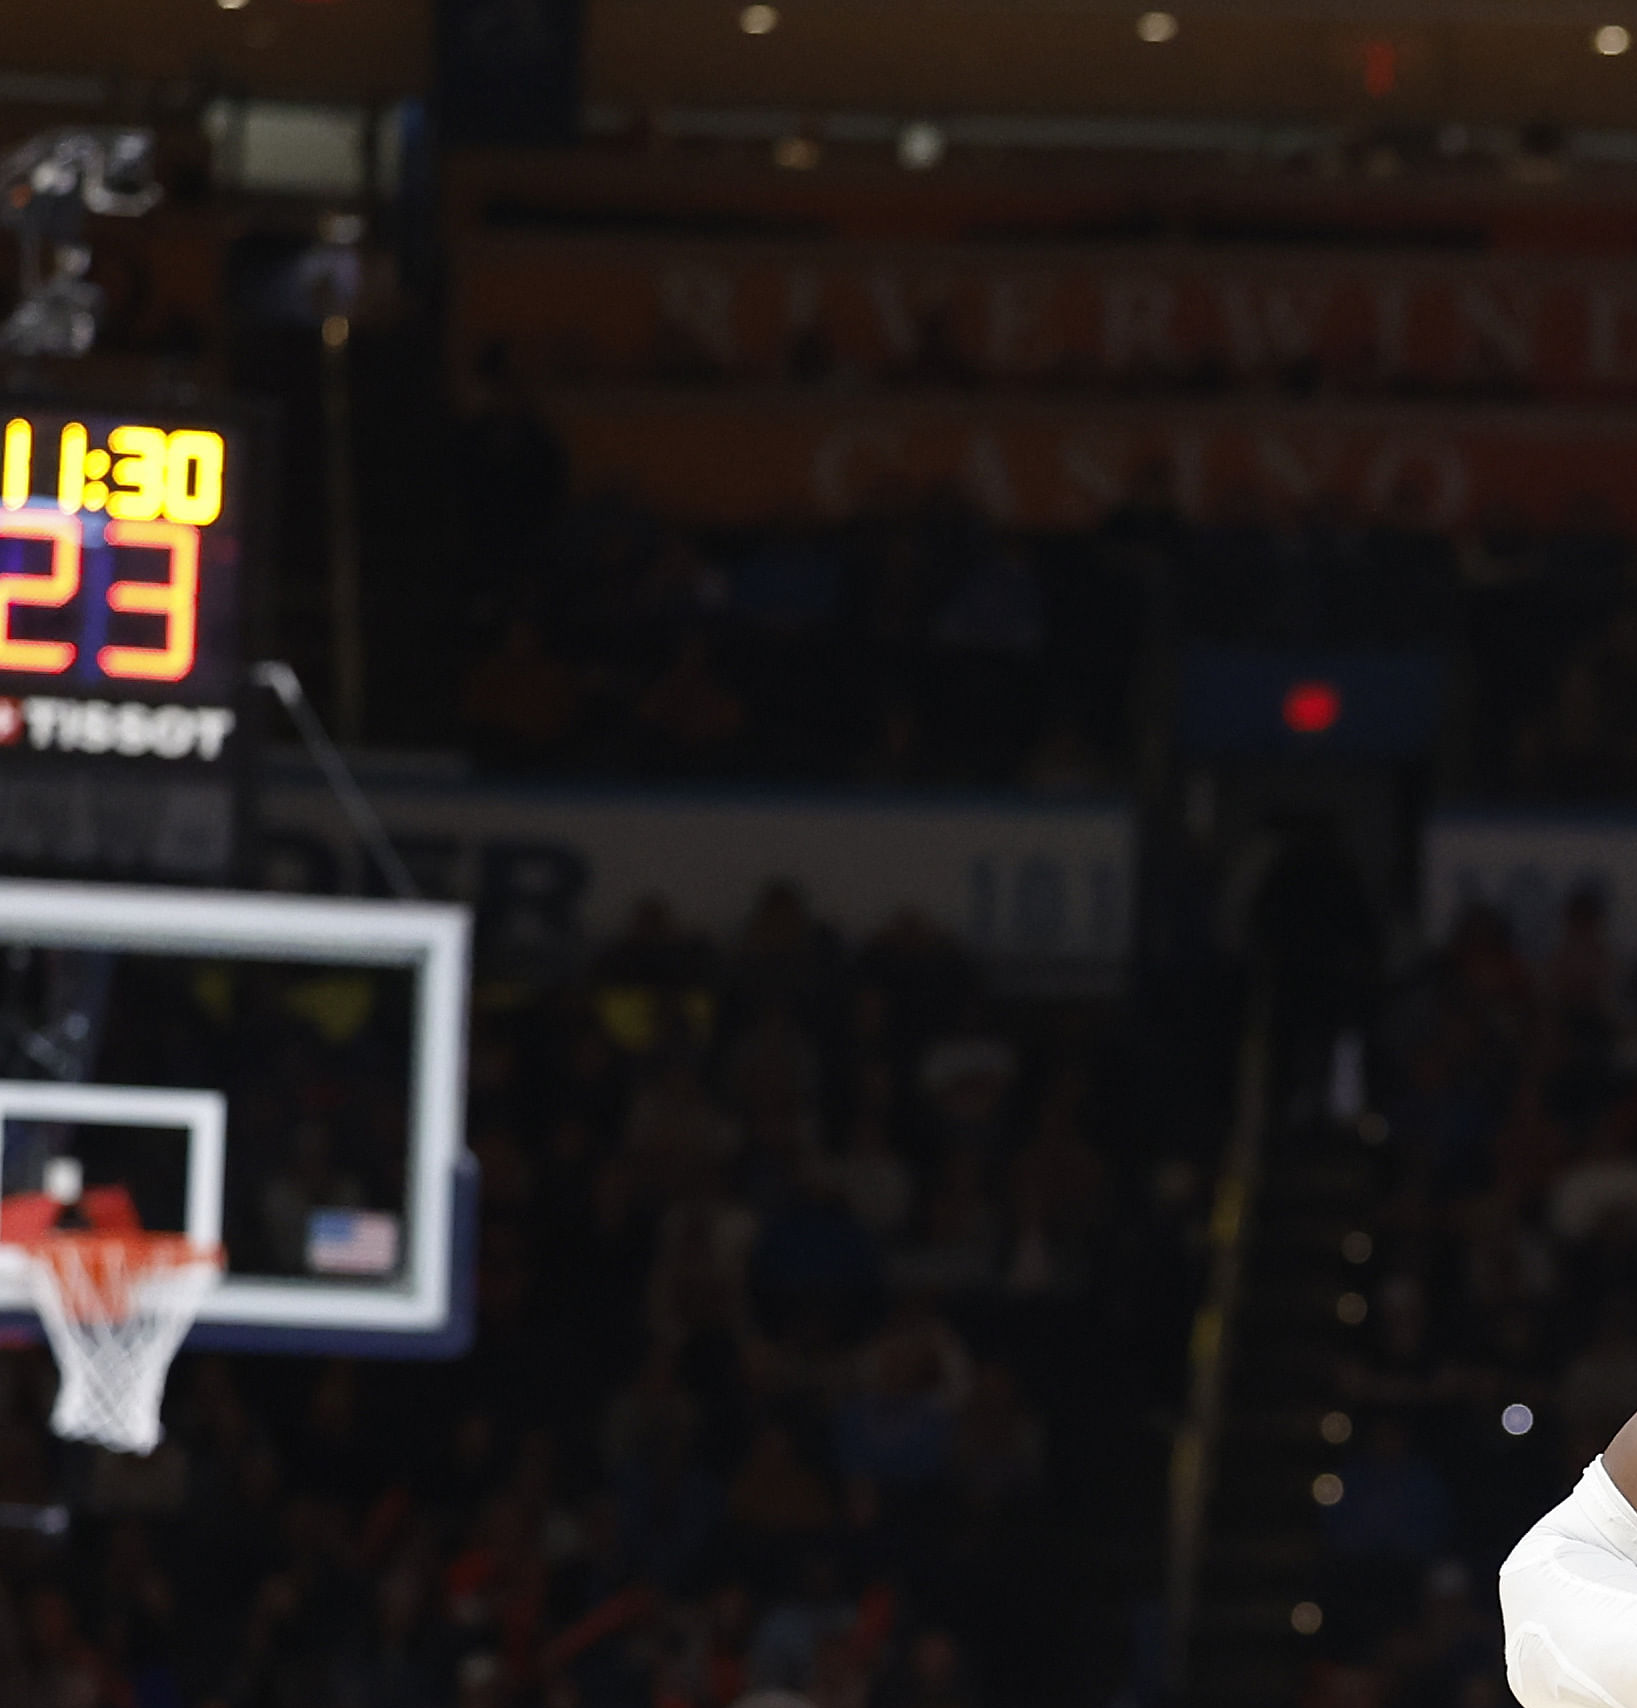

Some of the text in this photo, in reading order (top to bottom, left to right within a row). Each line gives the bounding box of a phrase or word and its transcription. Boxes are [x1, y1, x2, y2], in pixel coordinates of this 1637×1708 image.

[2, 417, 226, 527] 11:30
[0, 507, 202, 683] 23
[26, 703, 235, 762] TISSOT
